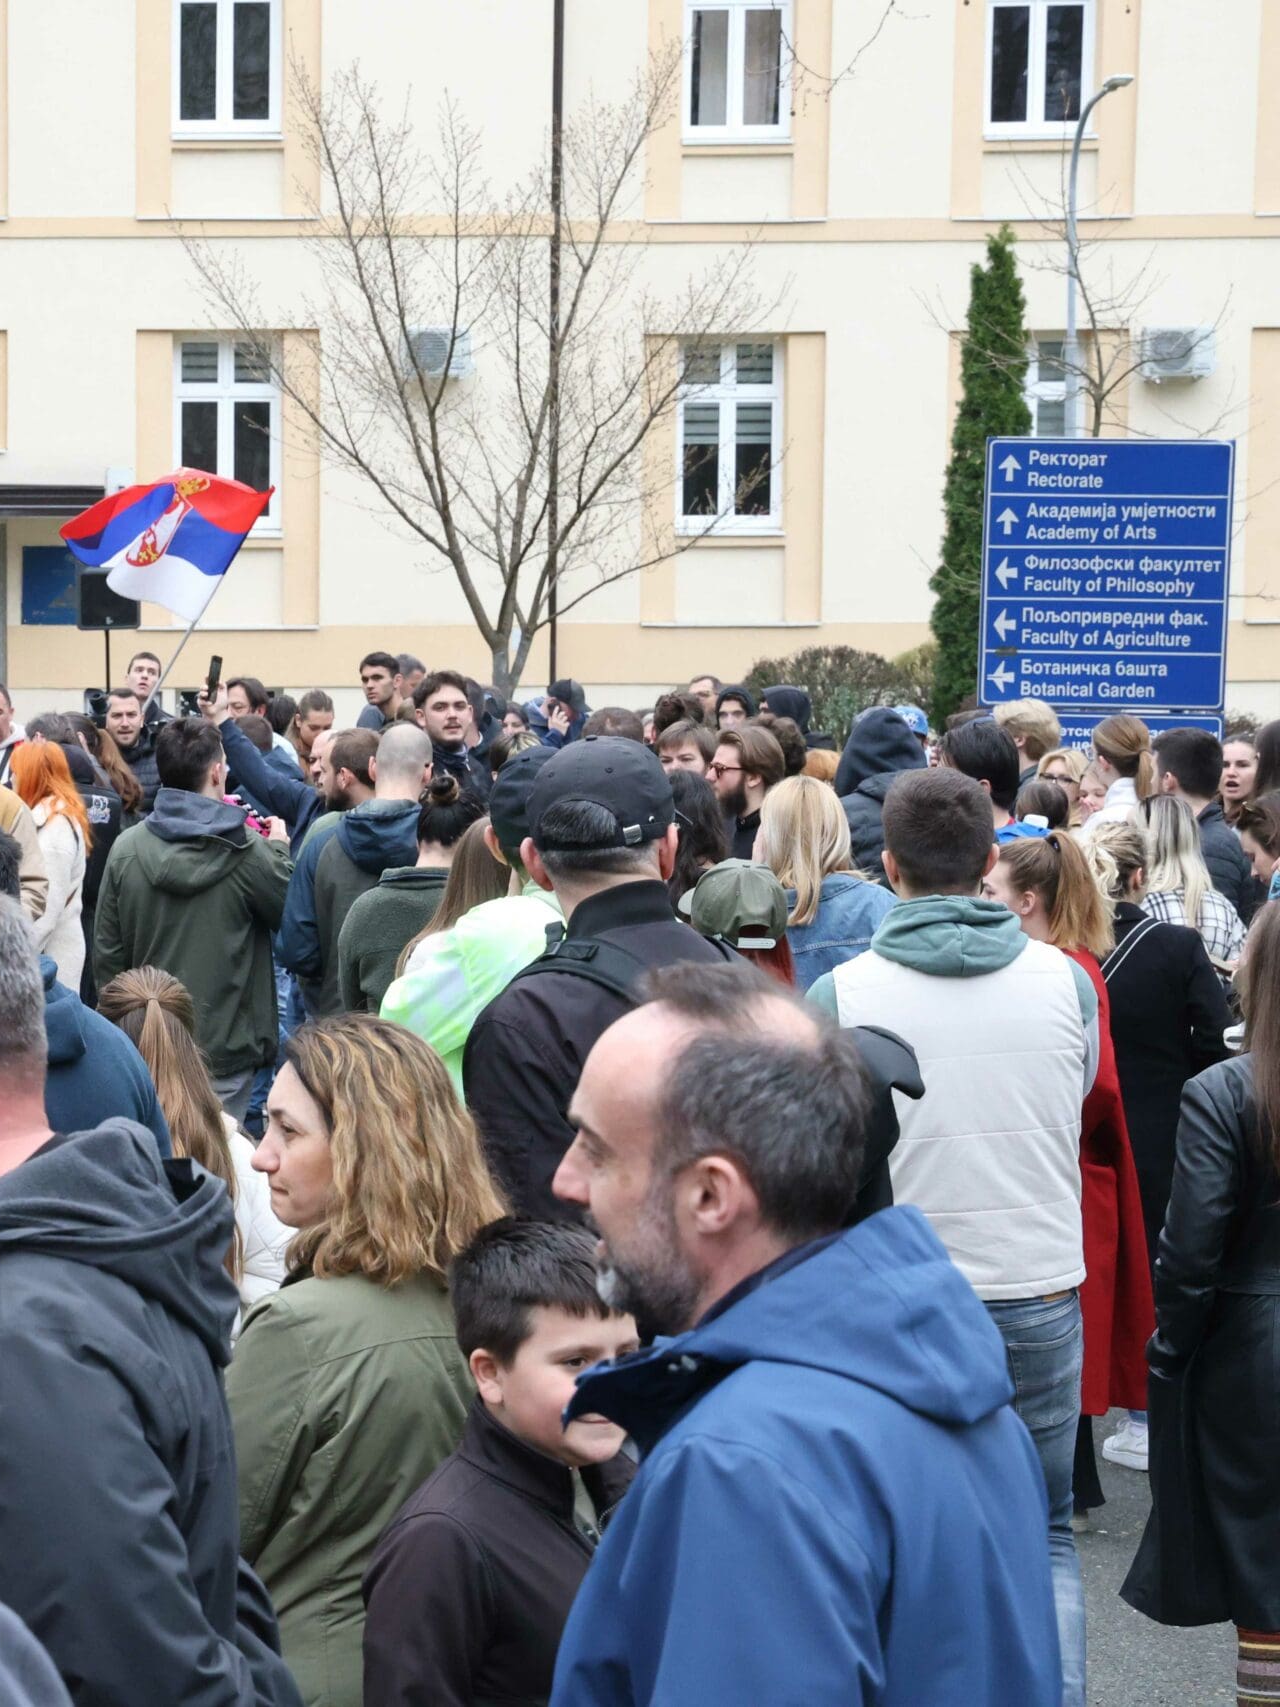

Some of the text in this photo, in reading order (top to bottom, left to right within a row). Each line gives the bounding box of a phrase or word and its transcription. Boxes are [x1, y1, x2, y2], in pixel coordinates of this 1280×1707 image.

[1029, 450, 1107, 469] Ректорат
[1027, 472, 1103, 488] Rectorate
[1026, 503, 1215, 523] Академија умјетности
[1026, 525, 1156, 543] Academy of Arts
[1024, 555, 1222, 575] Филозофски факултет
[1024, 576, 1194, 597] Faculty of Philosophy
[1022, 607, 1208, 628] Пољопривредни фак.
[1021, 629, 1191, 649] Faculty of Agriculture
[1021, 659, 1167, 676] Ботаничка башта
[1020, 681, 1155, 697] Botanical Garden
